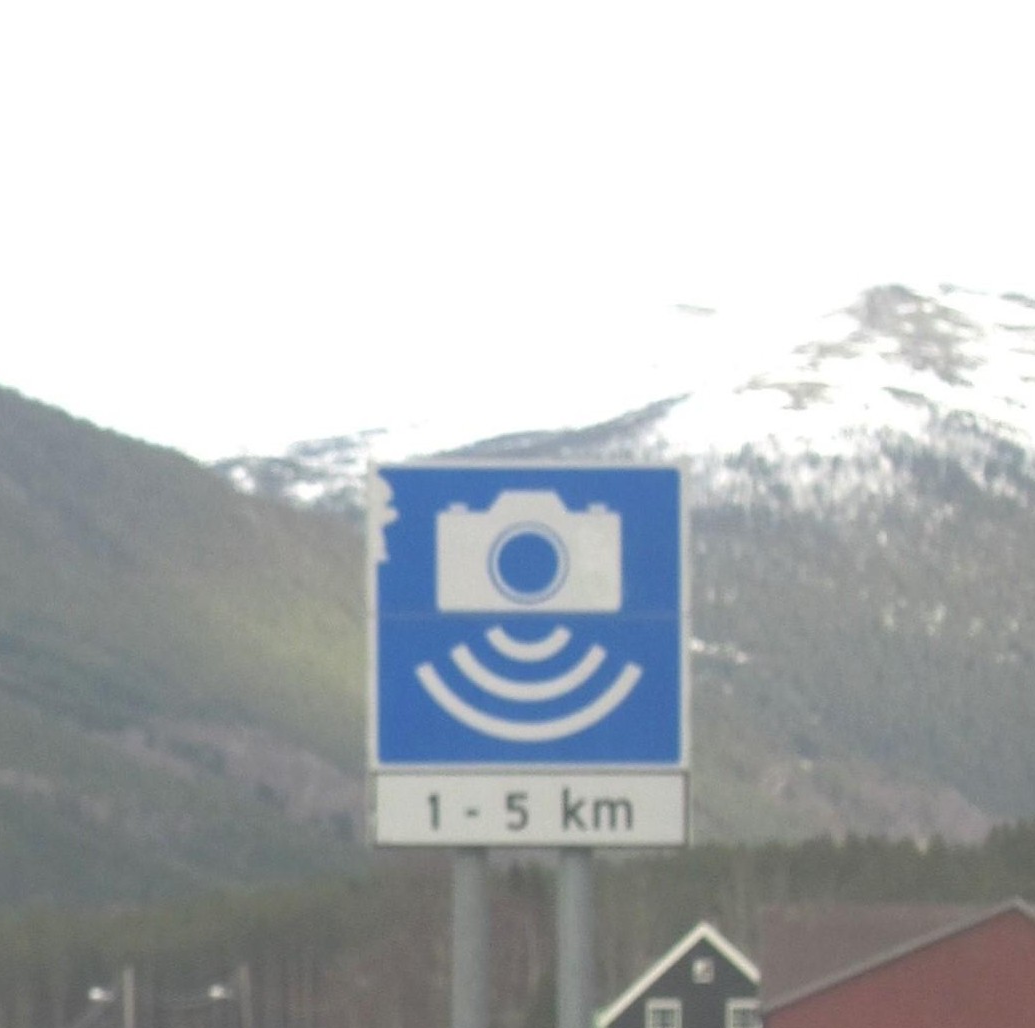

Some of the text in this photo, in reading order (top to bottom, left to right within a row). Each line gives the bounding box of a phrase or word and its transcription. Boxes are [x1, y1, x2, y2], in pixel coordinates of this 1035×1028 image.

[428, 793, 439, 830] 1
[506, 793, 528, 830] 5
[562, 787, 633, 830] km
